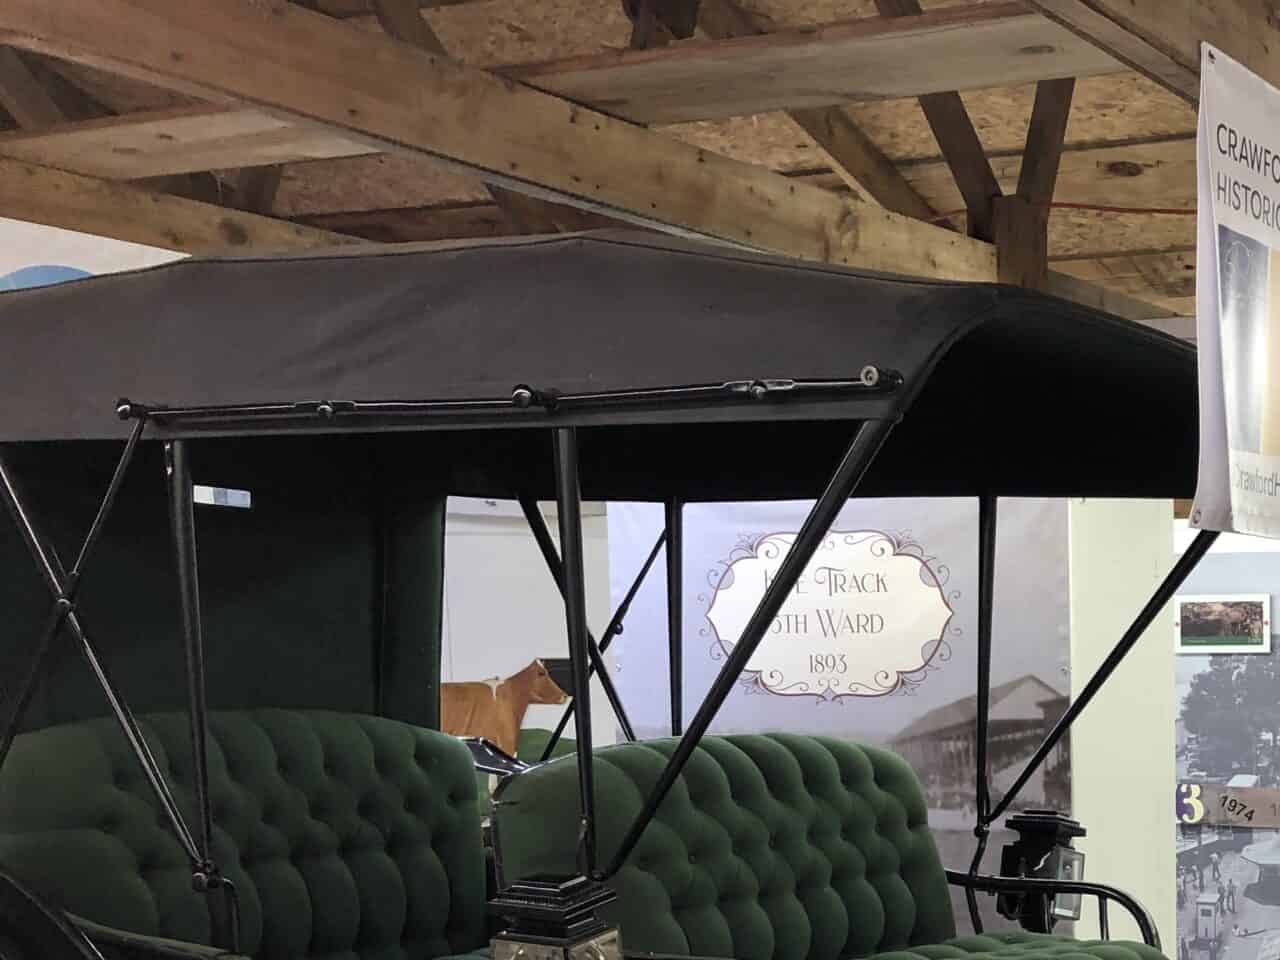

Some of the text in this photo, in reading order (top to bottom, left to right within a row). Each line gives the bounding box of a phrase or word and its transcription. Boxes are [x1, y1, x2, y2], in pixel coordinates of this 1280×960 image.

[815, 566, 889, 597] TRACK
[815, 608, 885, 639] WARD
[809, 653, 848, 674] 1893
[1220, 794, 1256, 822] 1974
